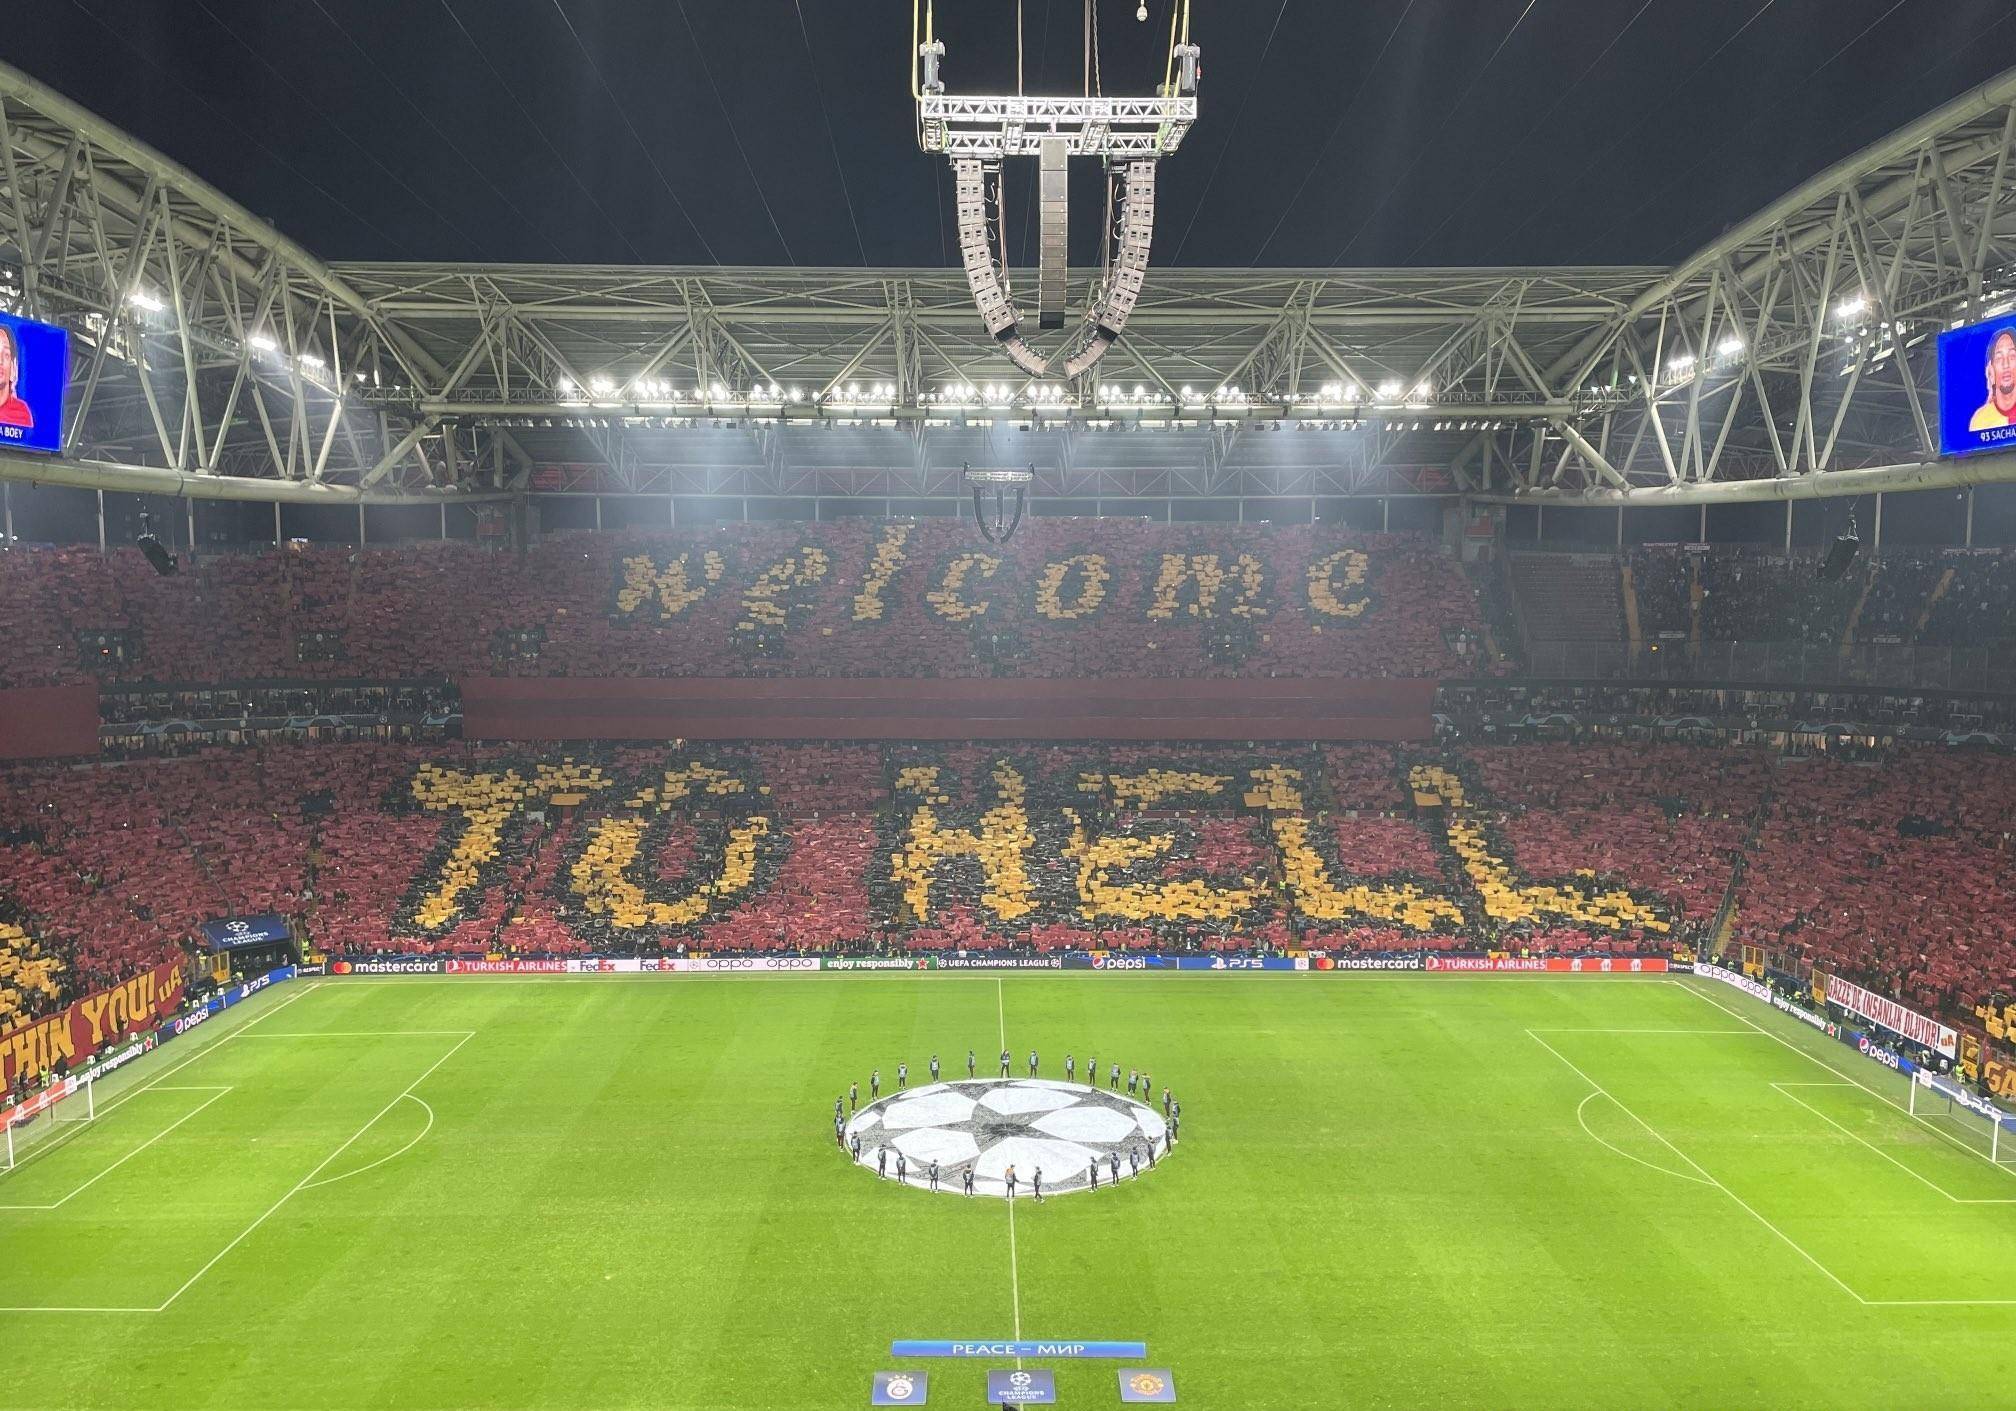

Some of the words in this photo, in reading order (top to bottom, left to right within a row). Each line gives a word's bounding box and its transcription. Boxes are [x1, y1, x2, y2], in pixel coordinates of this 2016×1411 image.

[5, 427, 23, 438] BOEY
[1981, 432, 1990, 442] 93
[411, 757, 777, 928] TO
[355, 960, 438, 973] mastercard
[464, 961, 514, 971] TURKISH
[517, 961, 567, 971] AIRLINES
[580, 960, 615, 972] FedEx
[640, 960, 675, 971] FedEx
[827, 958, 854, 969] enjoy
[856, 957, 914, 969] responsibly
[948, 959, 969, 967] UEFA
[970, 959, 1018, 967] CHAMPIONS
[1019, 959, 1050, 967] LEAGUE
[1107, 957, 1146, 970] pepsi
[1229, 959, 1264, 968] PS5
[1337, 958, 1419, 969] mastercard
[1445, 960, 1494, 970] TURKISH
[1497, 960, 1546, 970] AIRLINES
[250, 974, 270, 992] PS5
[82, 970, 157, 1045] YOU!
[1773, 997, 1790, 1012] enjoy
[1790, 1004, 1827, 1030] responsibly
[185, 1006, 209, 1030] pepsi
[101, 1042, 143, 1072] responsibly
[1869, 1044, 1900, 1069] pepsi
[952, 1344, 1016, 1355] PEACE
[1037, 1344, 1086, 1355] МИР
